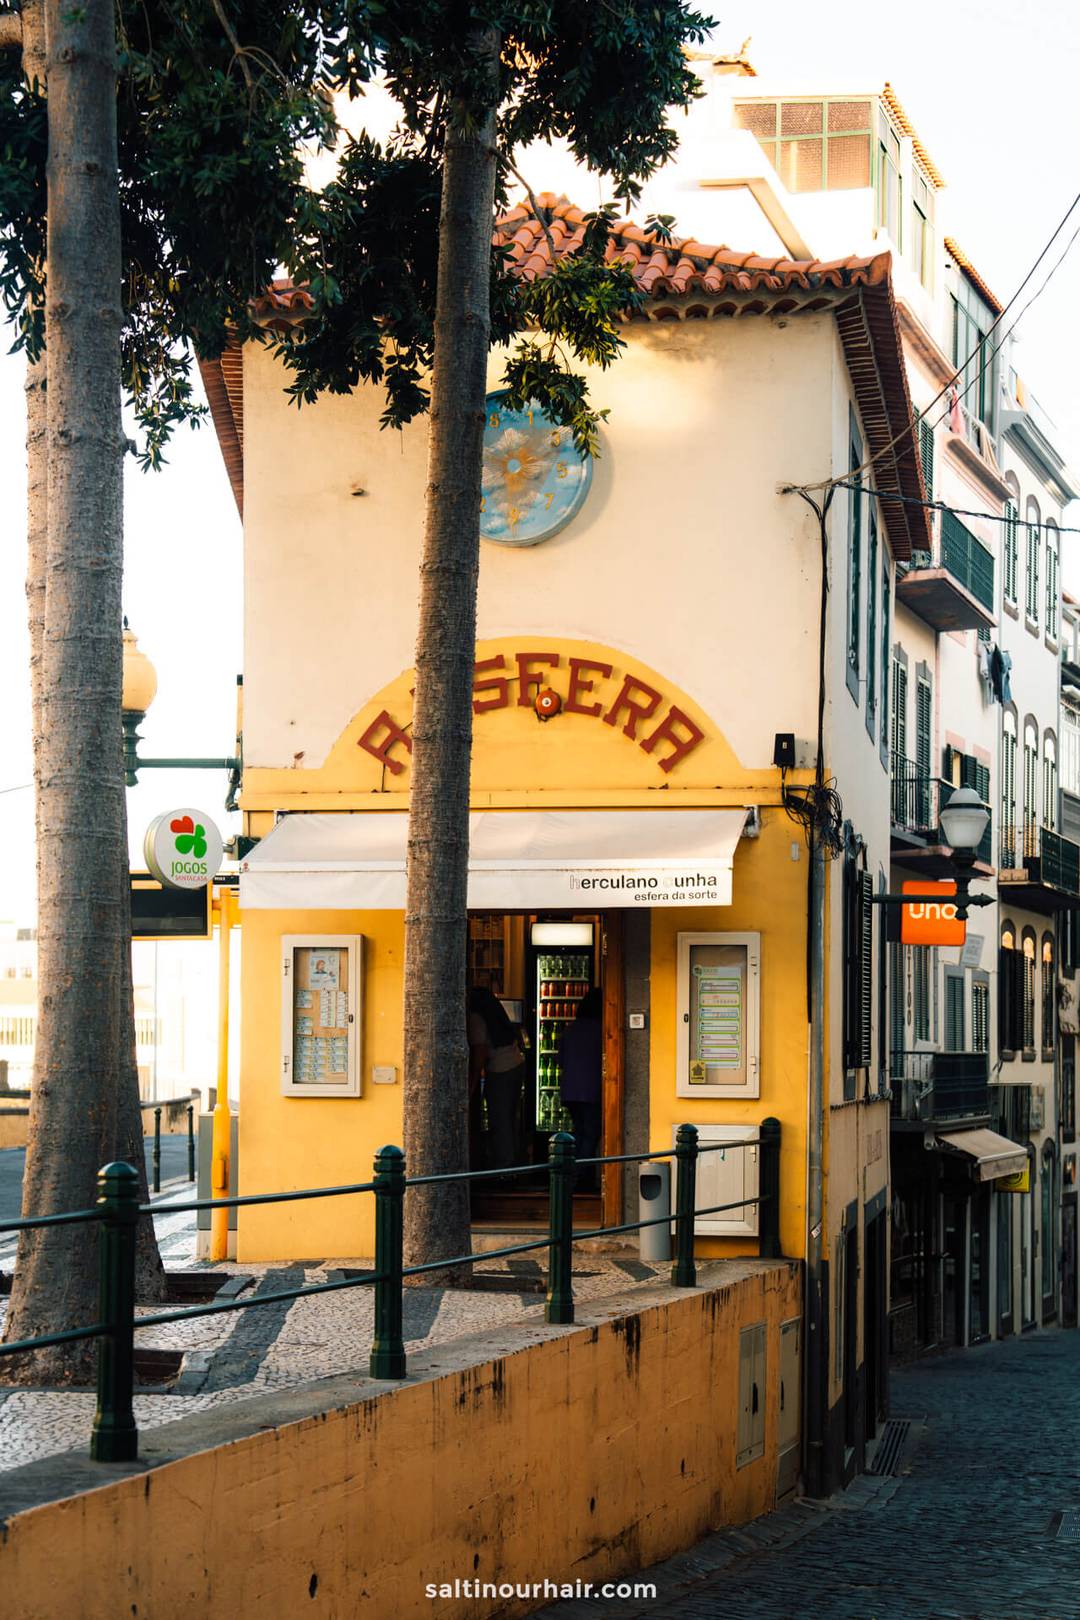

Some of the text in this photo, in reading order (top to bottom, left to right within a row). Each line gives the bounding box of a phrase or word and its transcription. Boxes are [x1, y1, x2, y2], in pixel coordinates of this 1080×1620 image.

[171, 861, 208, 877] JOGOS
[634, 889, 718, 902] esfera da sorte
